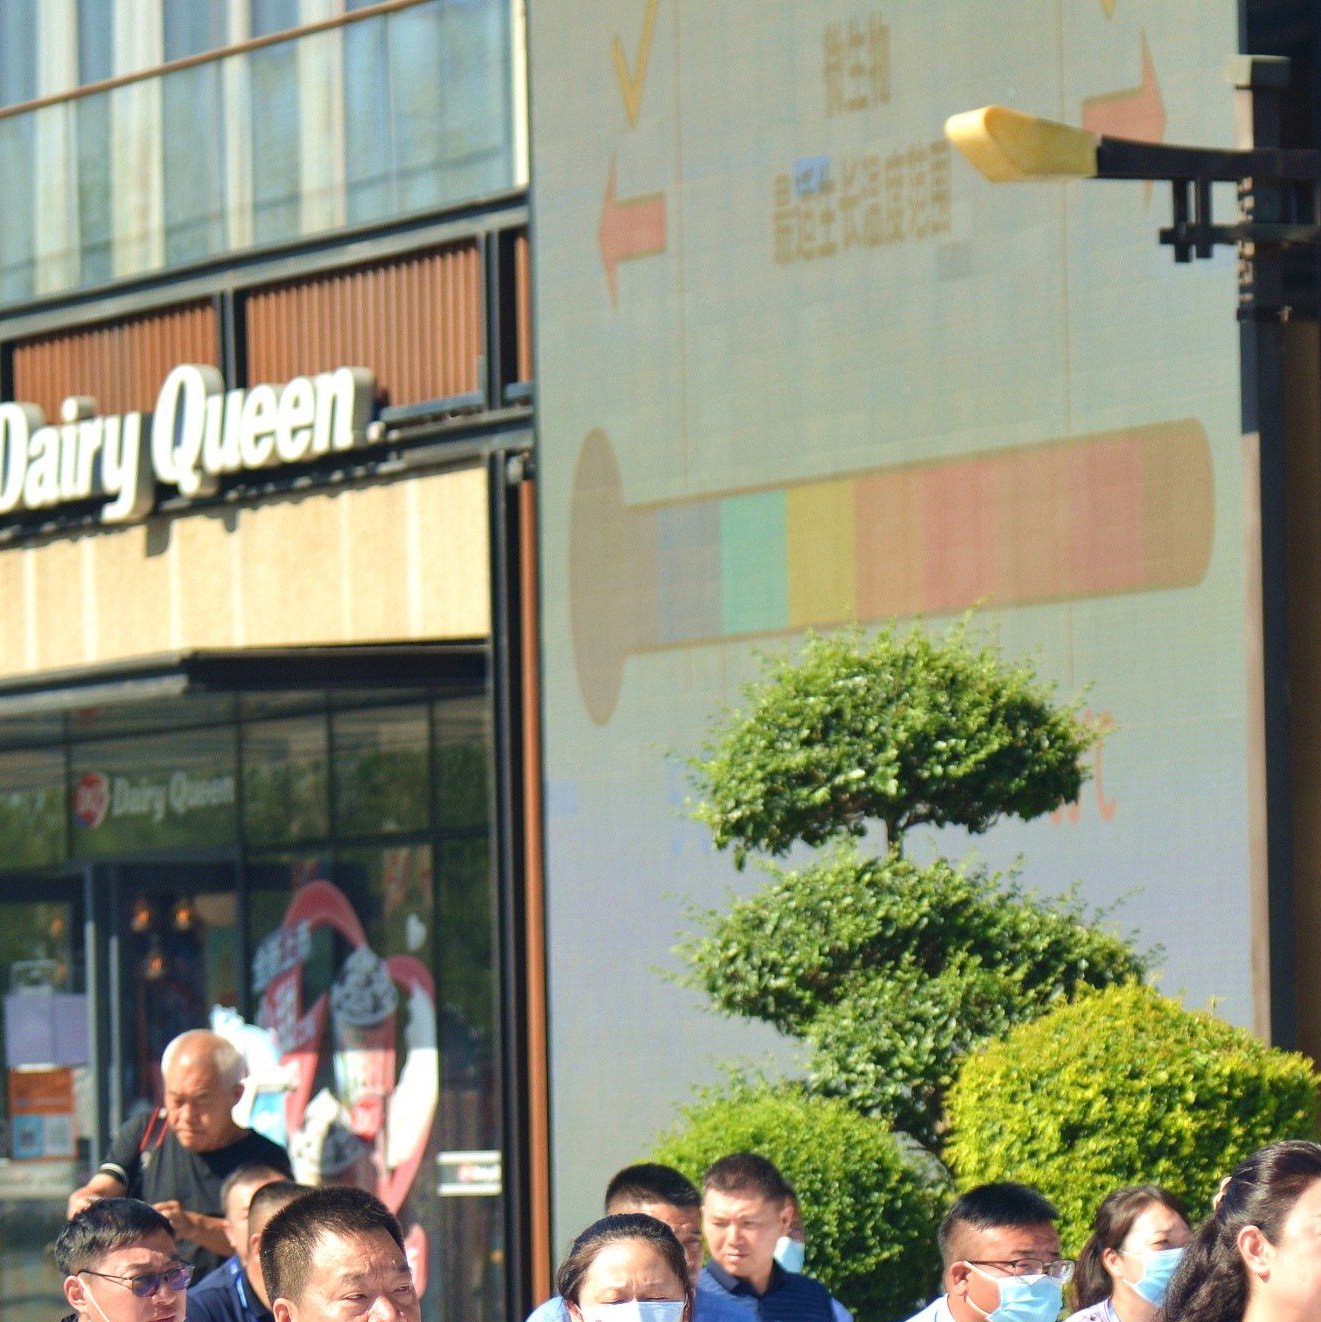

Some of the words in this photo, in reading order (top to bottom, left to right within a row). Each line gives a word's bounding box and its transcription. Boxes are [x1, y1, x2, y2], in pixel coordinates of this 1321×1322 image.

[151, 363, 356, 497] Queen
[113, 777, 166, 822] Dairy
[169, 770, 234, 815] Queen
